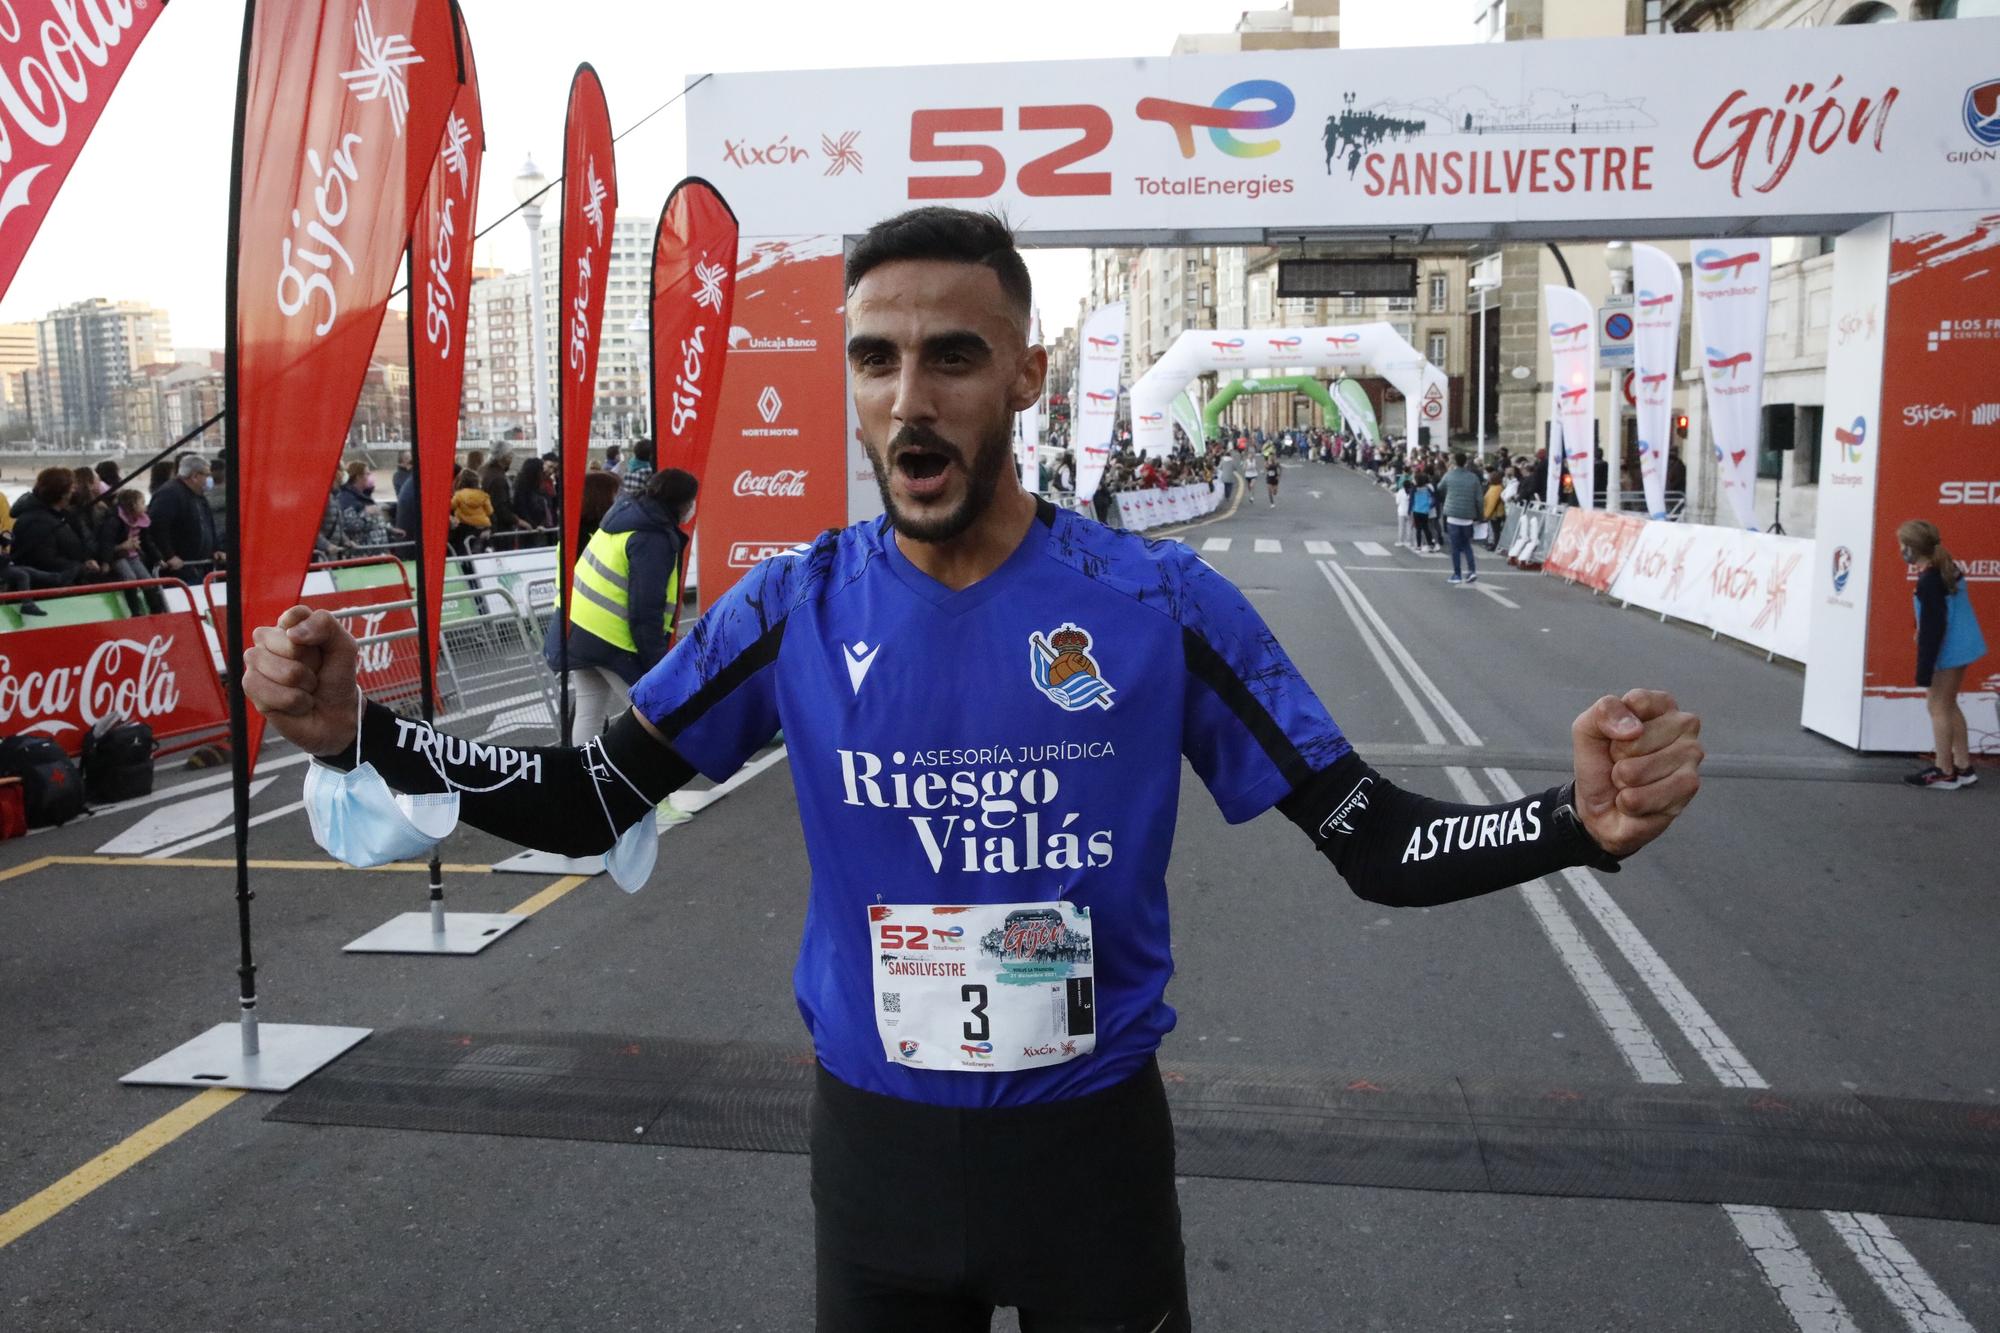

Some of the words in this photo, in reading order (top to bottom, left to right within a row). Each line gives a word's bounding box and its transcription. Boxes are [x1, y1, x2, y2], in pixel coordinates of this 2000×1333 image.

[907, 104, 1113, 200] 52
[1693, 74, 1899, 197] Gijón
[1946, 148, 1996, 164] GIJÓN
[1136, 175, 1294, 199] TotalEnergies
[1364, 146, 1655, 197] SANSILVESTRE
[749, 336, 786, 351] Unicaja
[787, 337, 817, 347] Banco
[1954, 319, 1981, 330] LOS
[742, 428, 769, 437] NORTE
[769, 428, 799, 437] MOTOR
[733, 469, 808, 497] Coca-Cola
[394, 718, 542, 784] TRIUMPH
[912, 744, 1014, 767] ASESORÍA
[1019, 740, 1116, 764] JURÍDICA
[837, 749, 1059, 829] Riesgo
[1328, 789, 1366, 830] TRIUMPH
[908, 812, 1114, 874] Vialás
[1401, 801, 1541, 864] ASTURIAS
[880, 925, 929, 950] 52
[1004, 916, 1067, 960] Gijón
[888, 961, 966, 977] SANSILVESTRE
[961, 984, 990, 1041] 3
